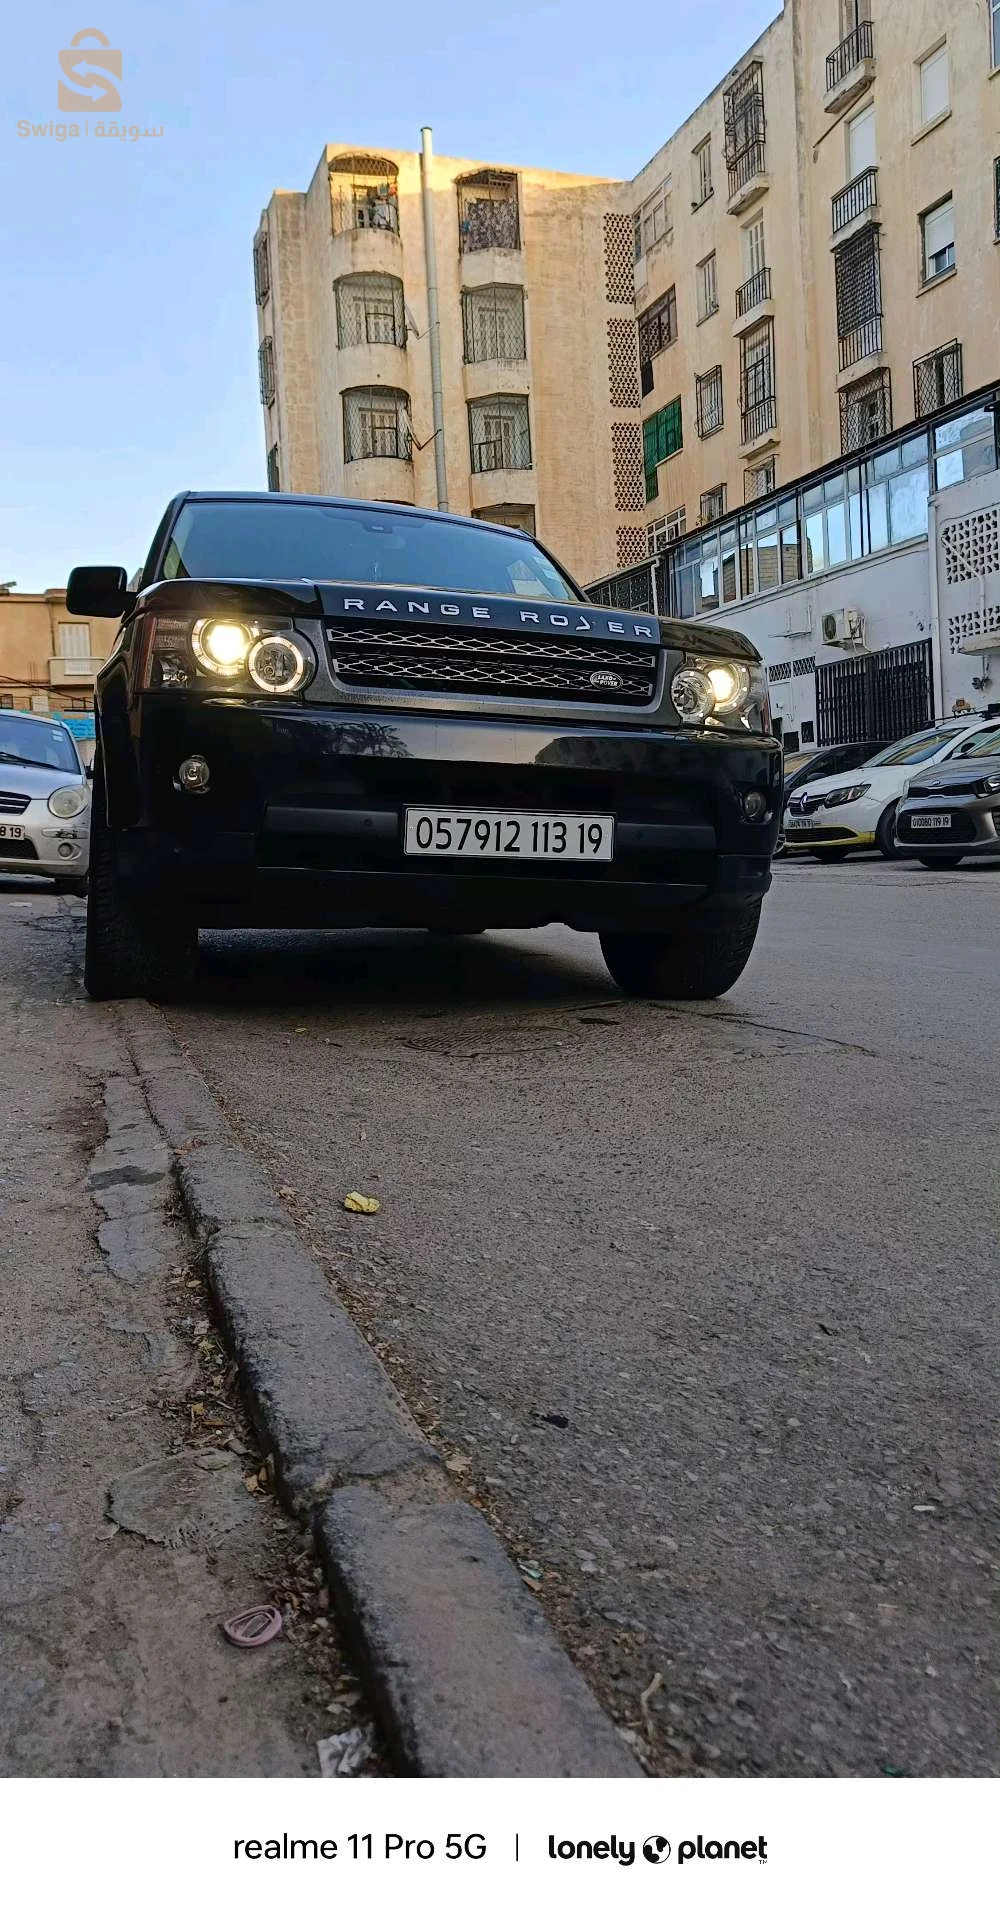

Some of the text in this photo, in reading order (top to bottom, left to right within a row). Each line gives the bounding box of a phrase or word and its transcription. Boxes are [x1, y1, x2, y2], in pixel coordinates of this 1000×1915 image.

[343, 598, 491, 619] RANGE
[10, 827, 22, 838] 19
[416, 816, 603, 854] 057912 113 19
